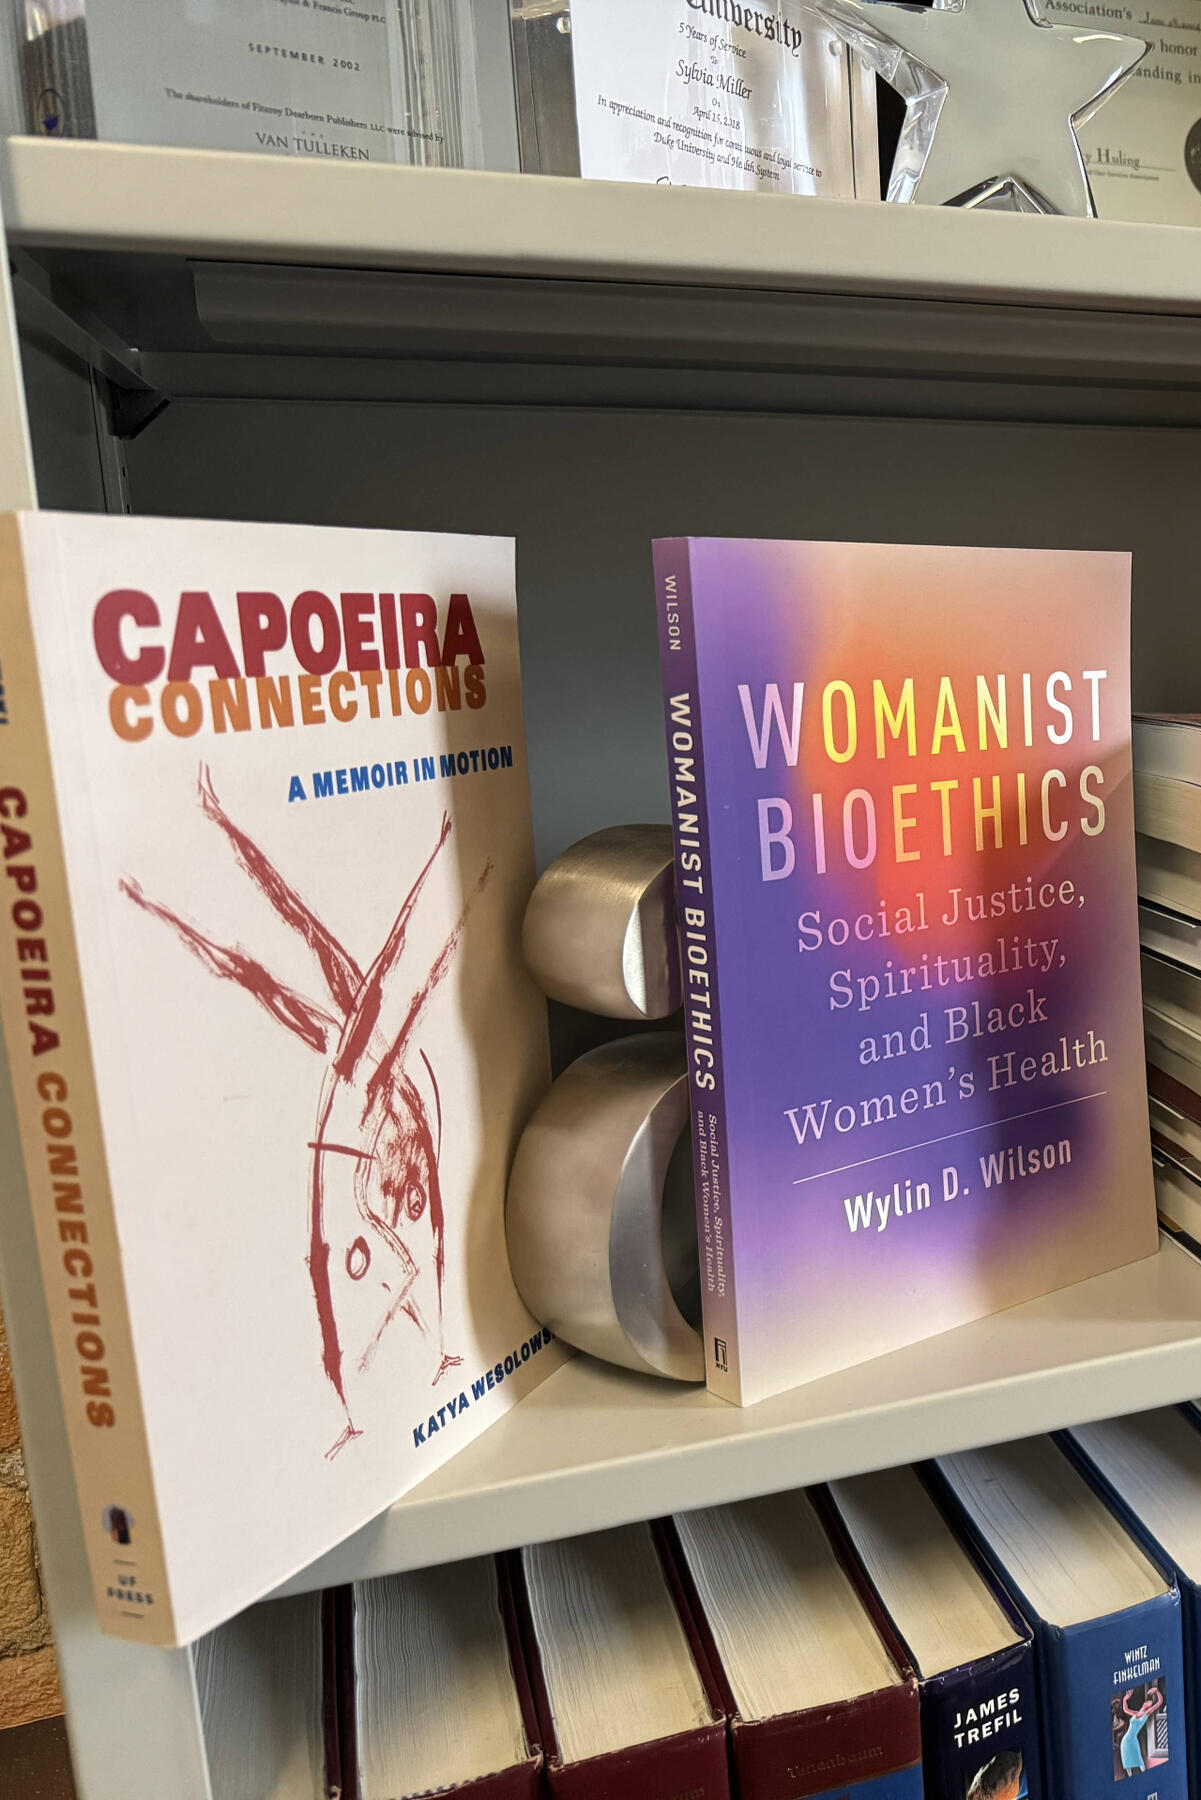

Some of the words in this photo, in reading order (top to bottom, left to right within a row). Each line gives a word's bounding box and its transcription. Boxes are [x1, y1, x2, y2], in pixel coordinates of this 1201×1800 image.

[1045, 0, 1132, 20] Association's
[248, 43, 325, 65] SEPTEMBER
[332, 59, 360, 71] 2002
[679, 22, 685, 33] 5
[686, 25, 708, 43] Years
[710, 36, 717, 51] of
[718, 39, 746, 58] Service
[1160, 39, 1198, 56] honor
[676, 60, 714, 86] Sylvia
[717, 73, 752, 100] Miller
[1189, 73, 1201, 83] in
[285, 107, 324, 122] Dearborn
[326, 115, 367, 129] Publishers
[370, 124, 385, 132] LLC
[609, 102, 655, 123] appreciation
[657, 116, 670, 128] and
[672, 121, 712, 141] recognition
[693, 106, 710, 121] April
[255, 131, 288, 148] VAN
[293, 138, 369, 160] TULLEKEN
[653, 133, 674, 150] Duke
[676, 138, 715, 162] University
[717, 153, 730, 166] and
[756, 163, 779, 181] System
[92, 589, 485, 685] CAPOEIRA
[664, 575, 681, 652] WILSON
[108, 662, 487, 742] CONNECTIONS
[737, 669, 1107, 769] WOMANIST
[288, 775, 307, 802] A
[312, 761, 409, 799] MEMOIR
[413, 757, 436, 782] IN
[438, 746, 513, 778] MOTION
[668, 692, 704, 895] WOMANIST
[757, 765, 1106, 882] BIOETHICS
[797, 891, 929, 953] Social
[941, 876, 1086, 928] Justice,
[828, 935, 1067, 1012] Spirituality,
[684, 907, 717, 1092] BIOETHICS
[859, 1013, 931, 1066] and
[945, 989, 1049, 1044] Black
[0, 786, 61, 1057] CAPOEIRA
[34, 1071, 116, 1430] CONNECTIONS
[783, 1068, 976, 1145] Women's
[988, 1030, 1109, 1093] Health
[700, 1139, 708, 1178] Black
[709, 1114, 719, 1157] Social
[843, 1178, 931, 1234] Wylin
[943, 1165, 969, 1202] D.
[979, 1139, 1074, 1190] Wilson
[702, 1179, 712, 1245] Women's
[705, 1246, 714, 1292] Health
[412, 1392, 470, 1448] KATYA
[471, 1327, 556, 1401] WESOLOWS
[1113, 1657, 1160, 1685] FINKELMAN
[1124, 1645, 1148, 1663] WINTZ
[953, 1688, 1020, 1729] JAMES
[953, 1712, 1022, 1748] TREFIL
